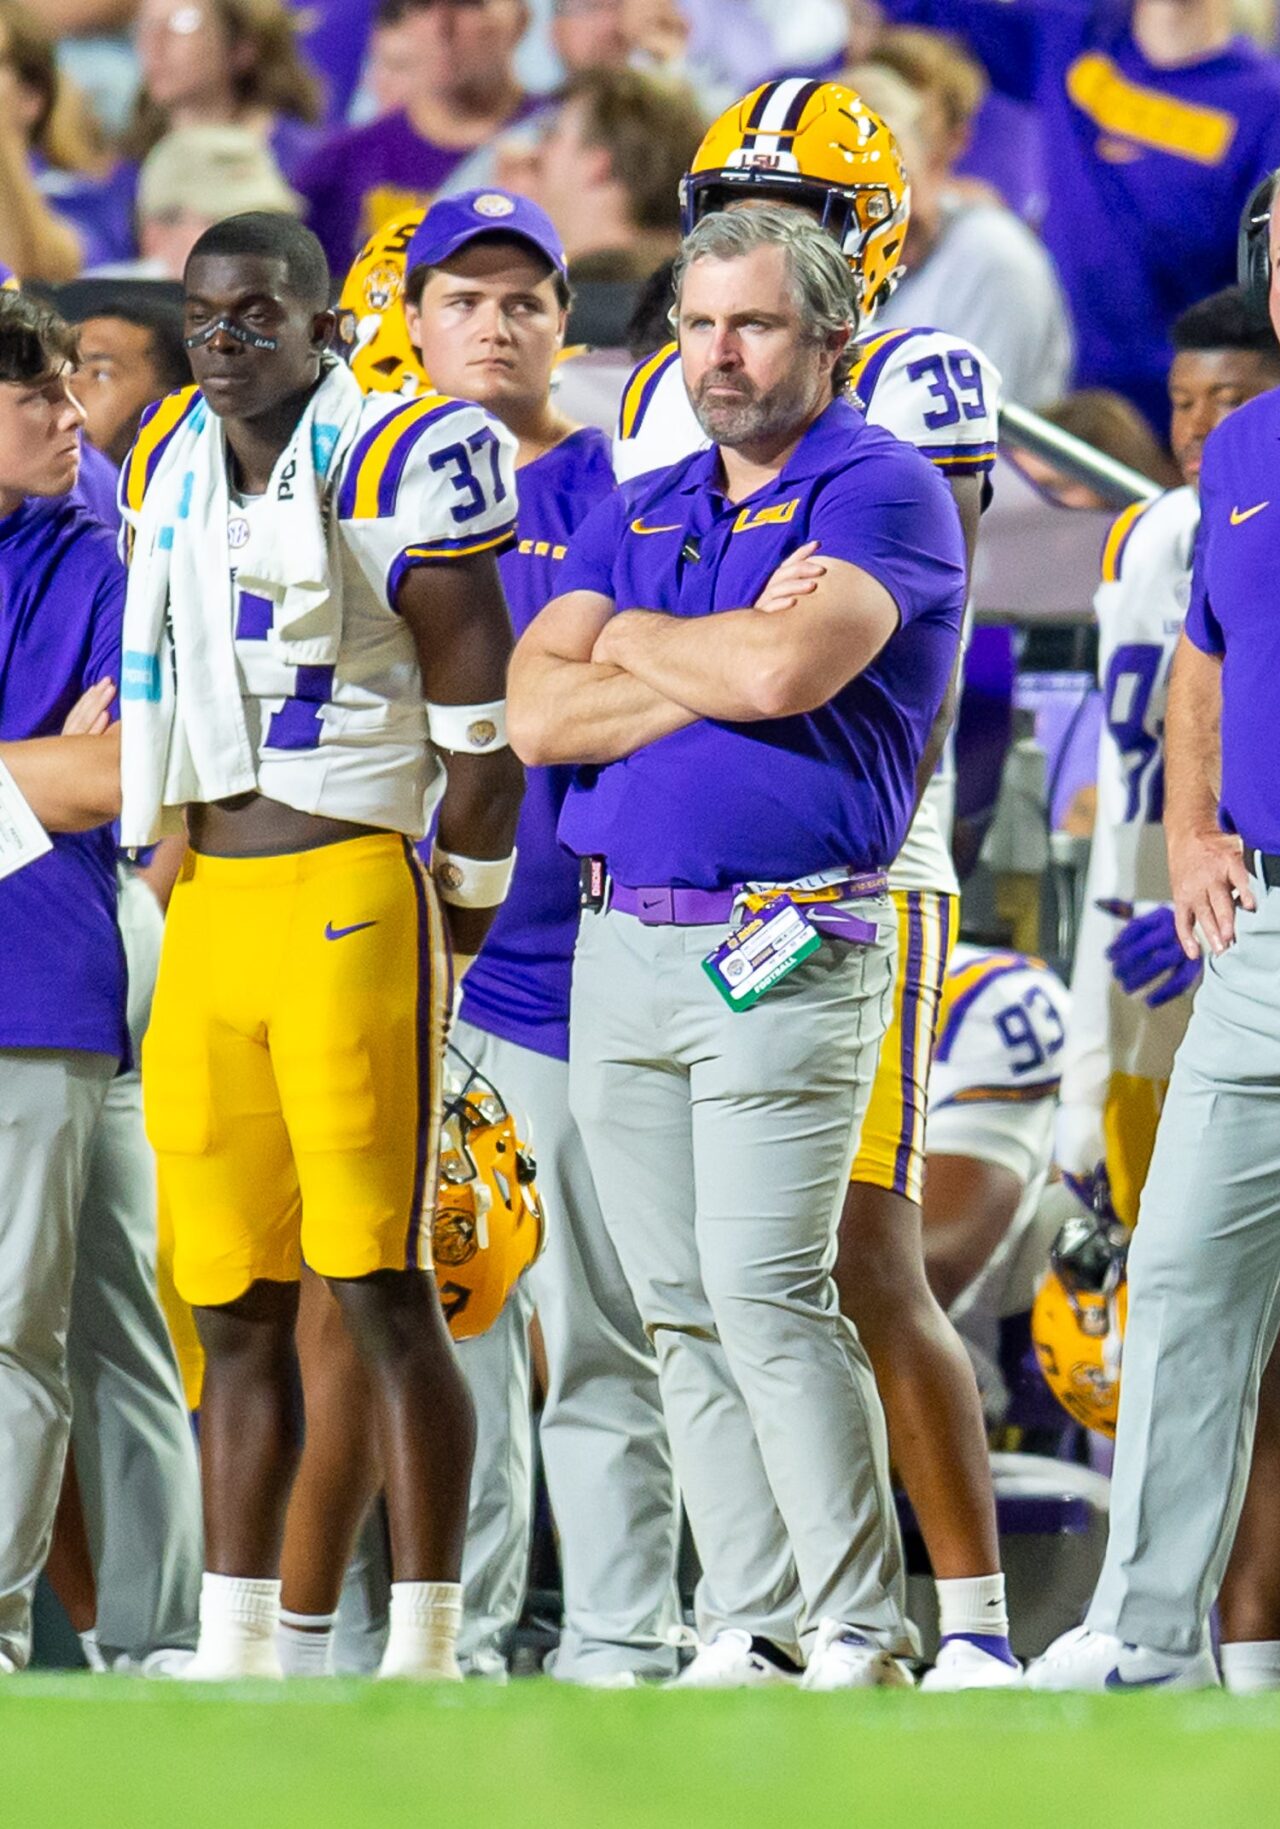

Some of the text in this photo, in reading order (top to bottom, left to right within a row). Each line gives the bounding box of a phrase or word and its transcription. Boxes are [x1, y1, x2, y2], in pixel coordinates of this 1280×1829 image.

[741, 153, 780, 168] LSU
[906, 349, 987, 430] 39
[428, 425, 507, 523] 37
[732, 498, 800, 533] LSU
[754, 957, 798, 994] FOOTBALL
[993, 985, 1065, 1077] 93
